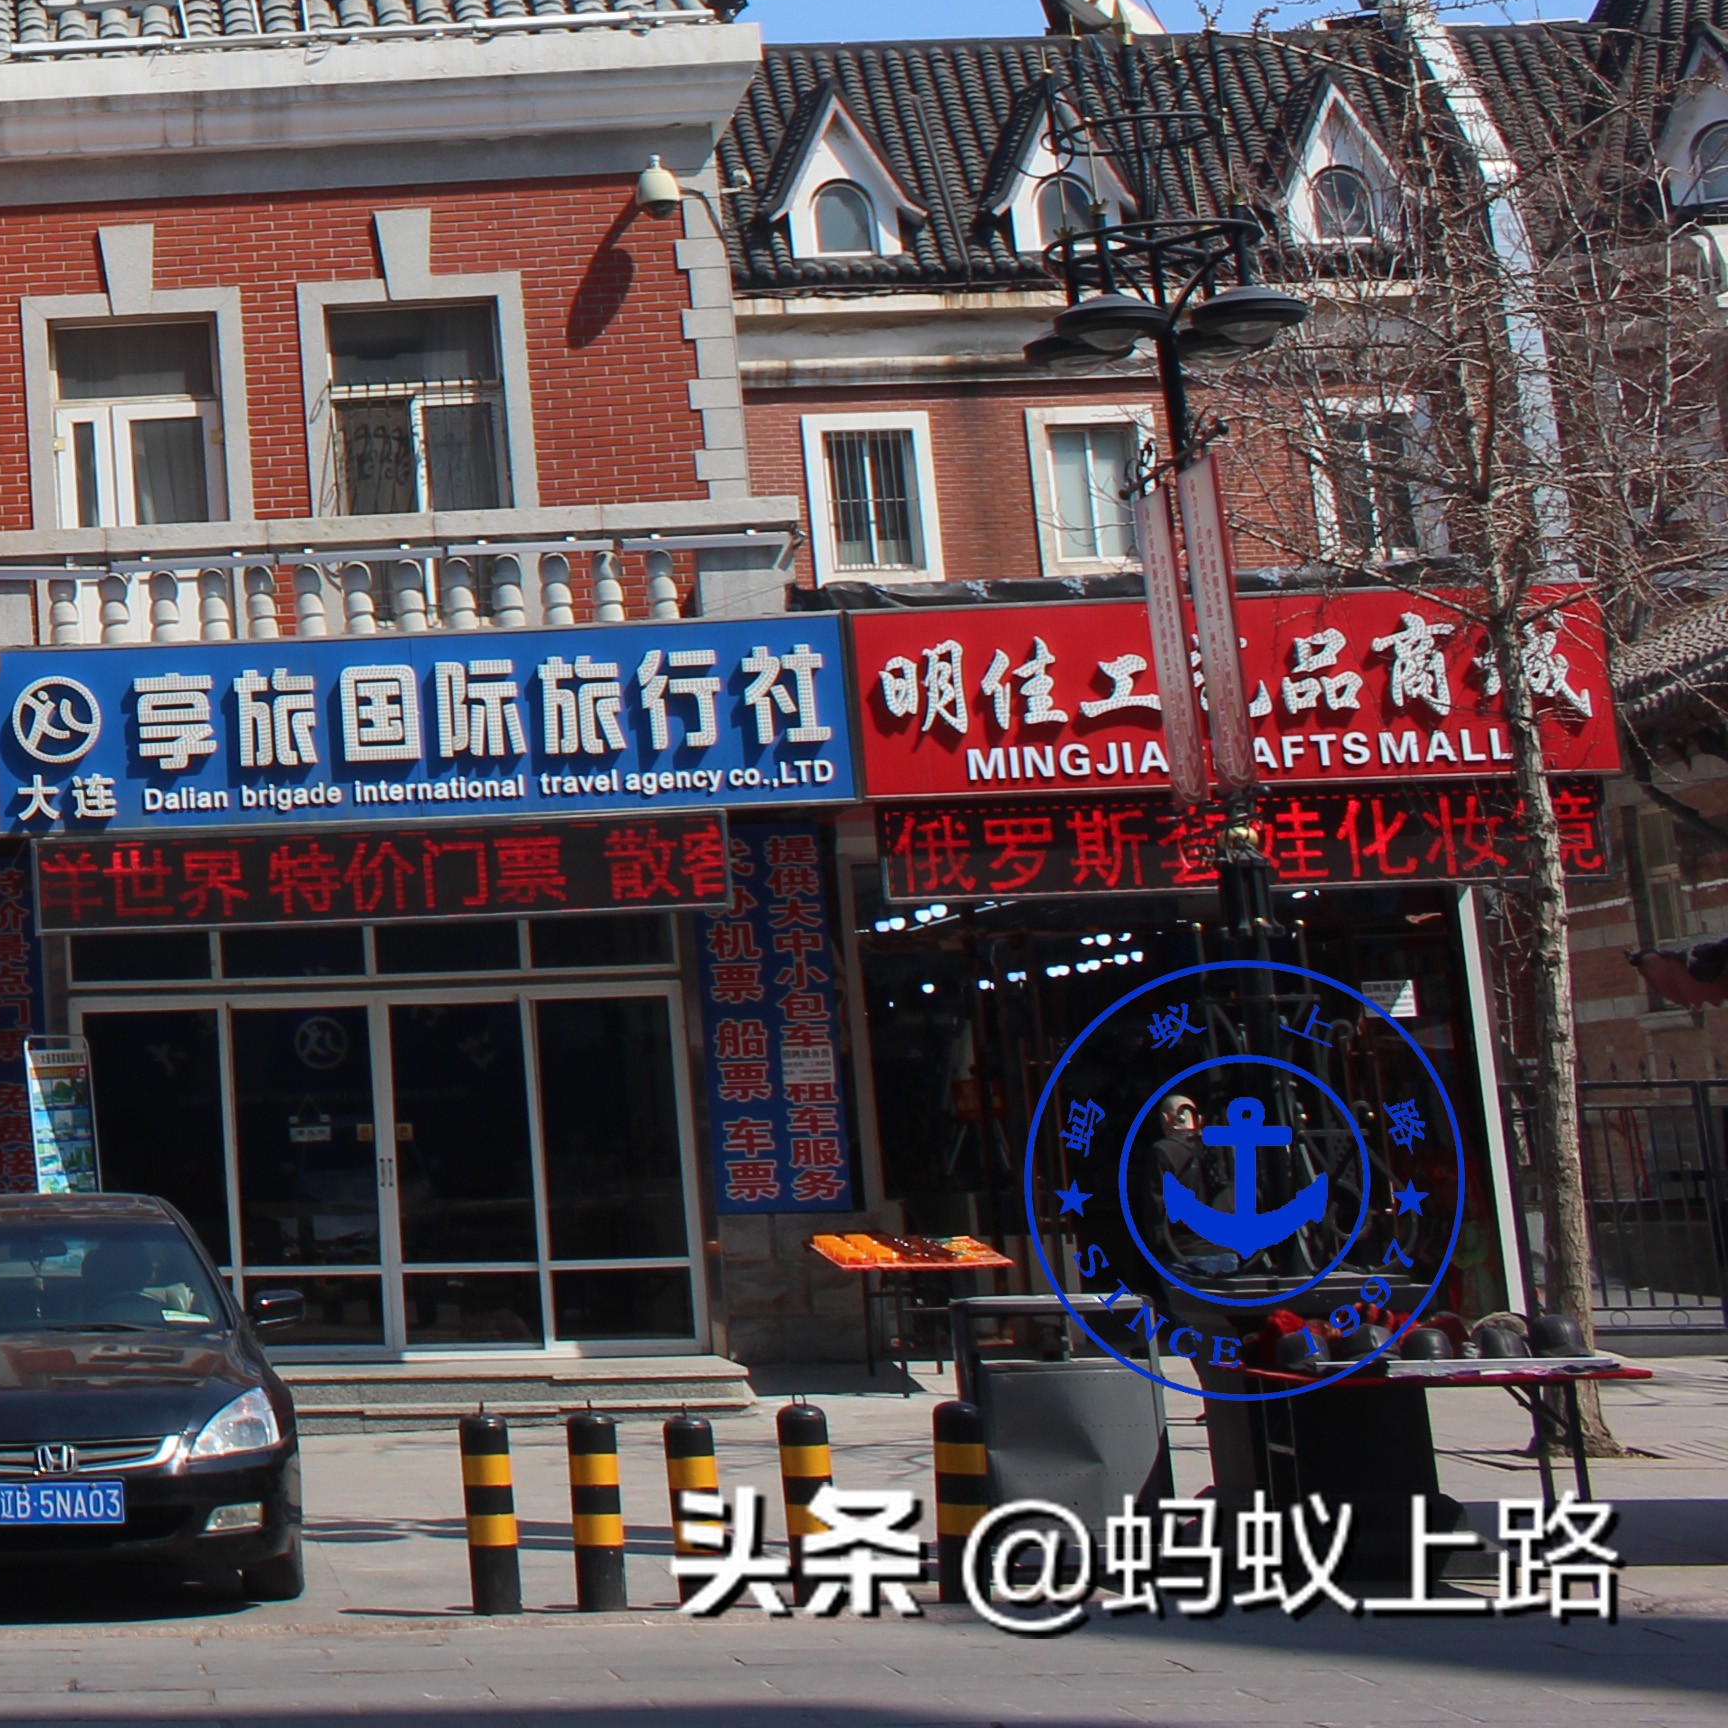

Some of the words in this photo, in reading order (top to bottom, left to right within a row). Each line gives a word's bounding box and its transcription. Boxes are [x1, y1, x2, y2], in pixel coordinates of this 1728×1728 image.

[134, 643, 834, 770] 享旅国际旅行社
[17, 772, 118, 823] 大连
[143, 787, 230, 812] Dalian
[241, 781, 343, 812] brigade
[354, 774, 525, 804] international
[539, 768, 620, 795] travel
[625, 768, 722, 795] agency
[269, 834, 568, 914] 特价门票
[715, 1019, 772, 1103] 船票
[722, 1116, 780, 1202] 车票
